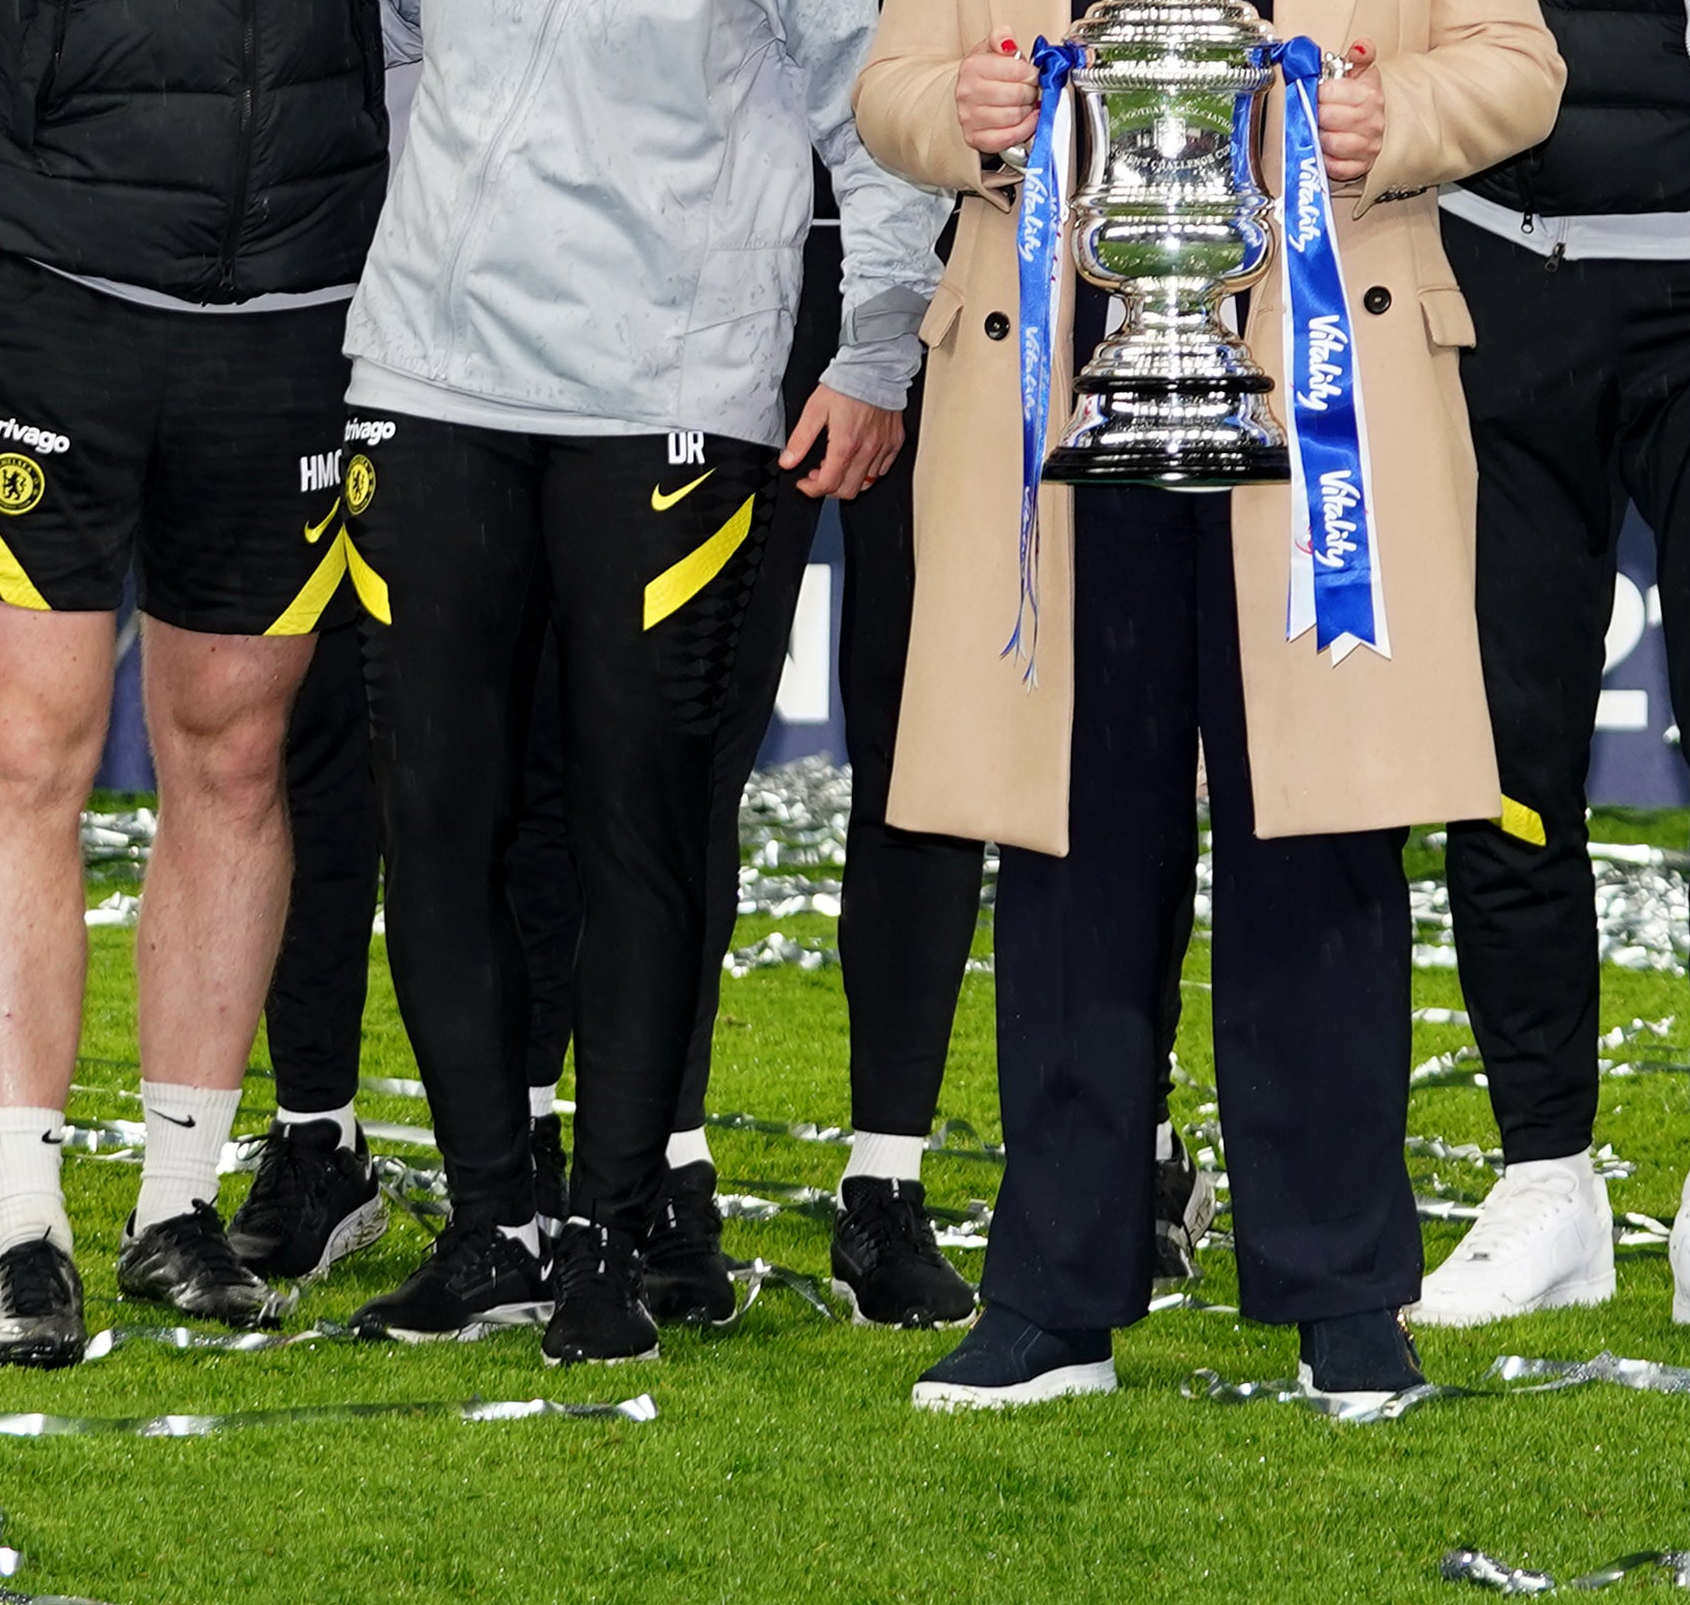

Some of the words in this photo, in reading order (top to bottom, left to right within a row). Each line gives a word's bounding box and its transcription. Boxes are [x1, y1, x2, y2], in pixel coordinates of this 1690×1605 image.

[1016, 167, 1044, 263] Vitality
[1286, 156, 1321, 254] Vitality
[1296, 314, 1349, 412] Vitality
[344, 416, 397, 446] trivago
[668, 430, 705, 465] DR
[1315, 469, 1358, 569] Vitality
